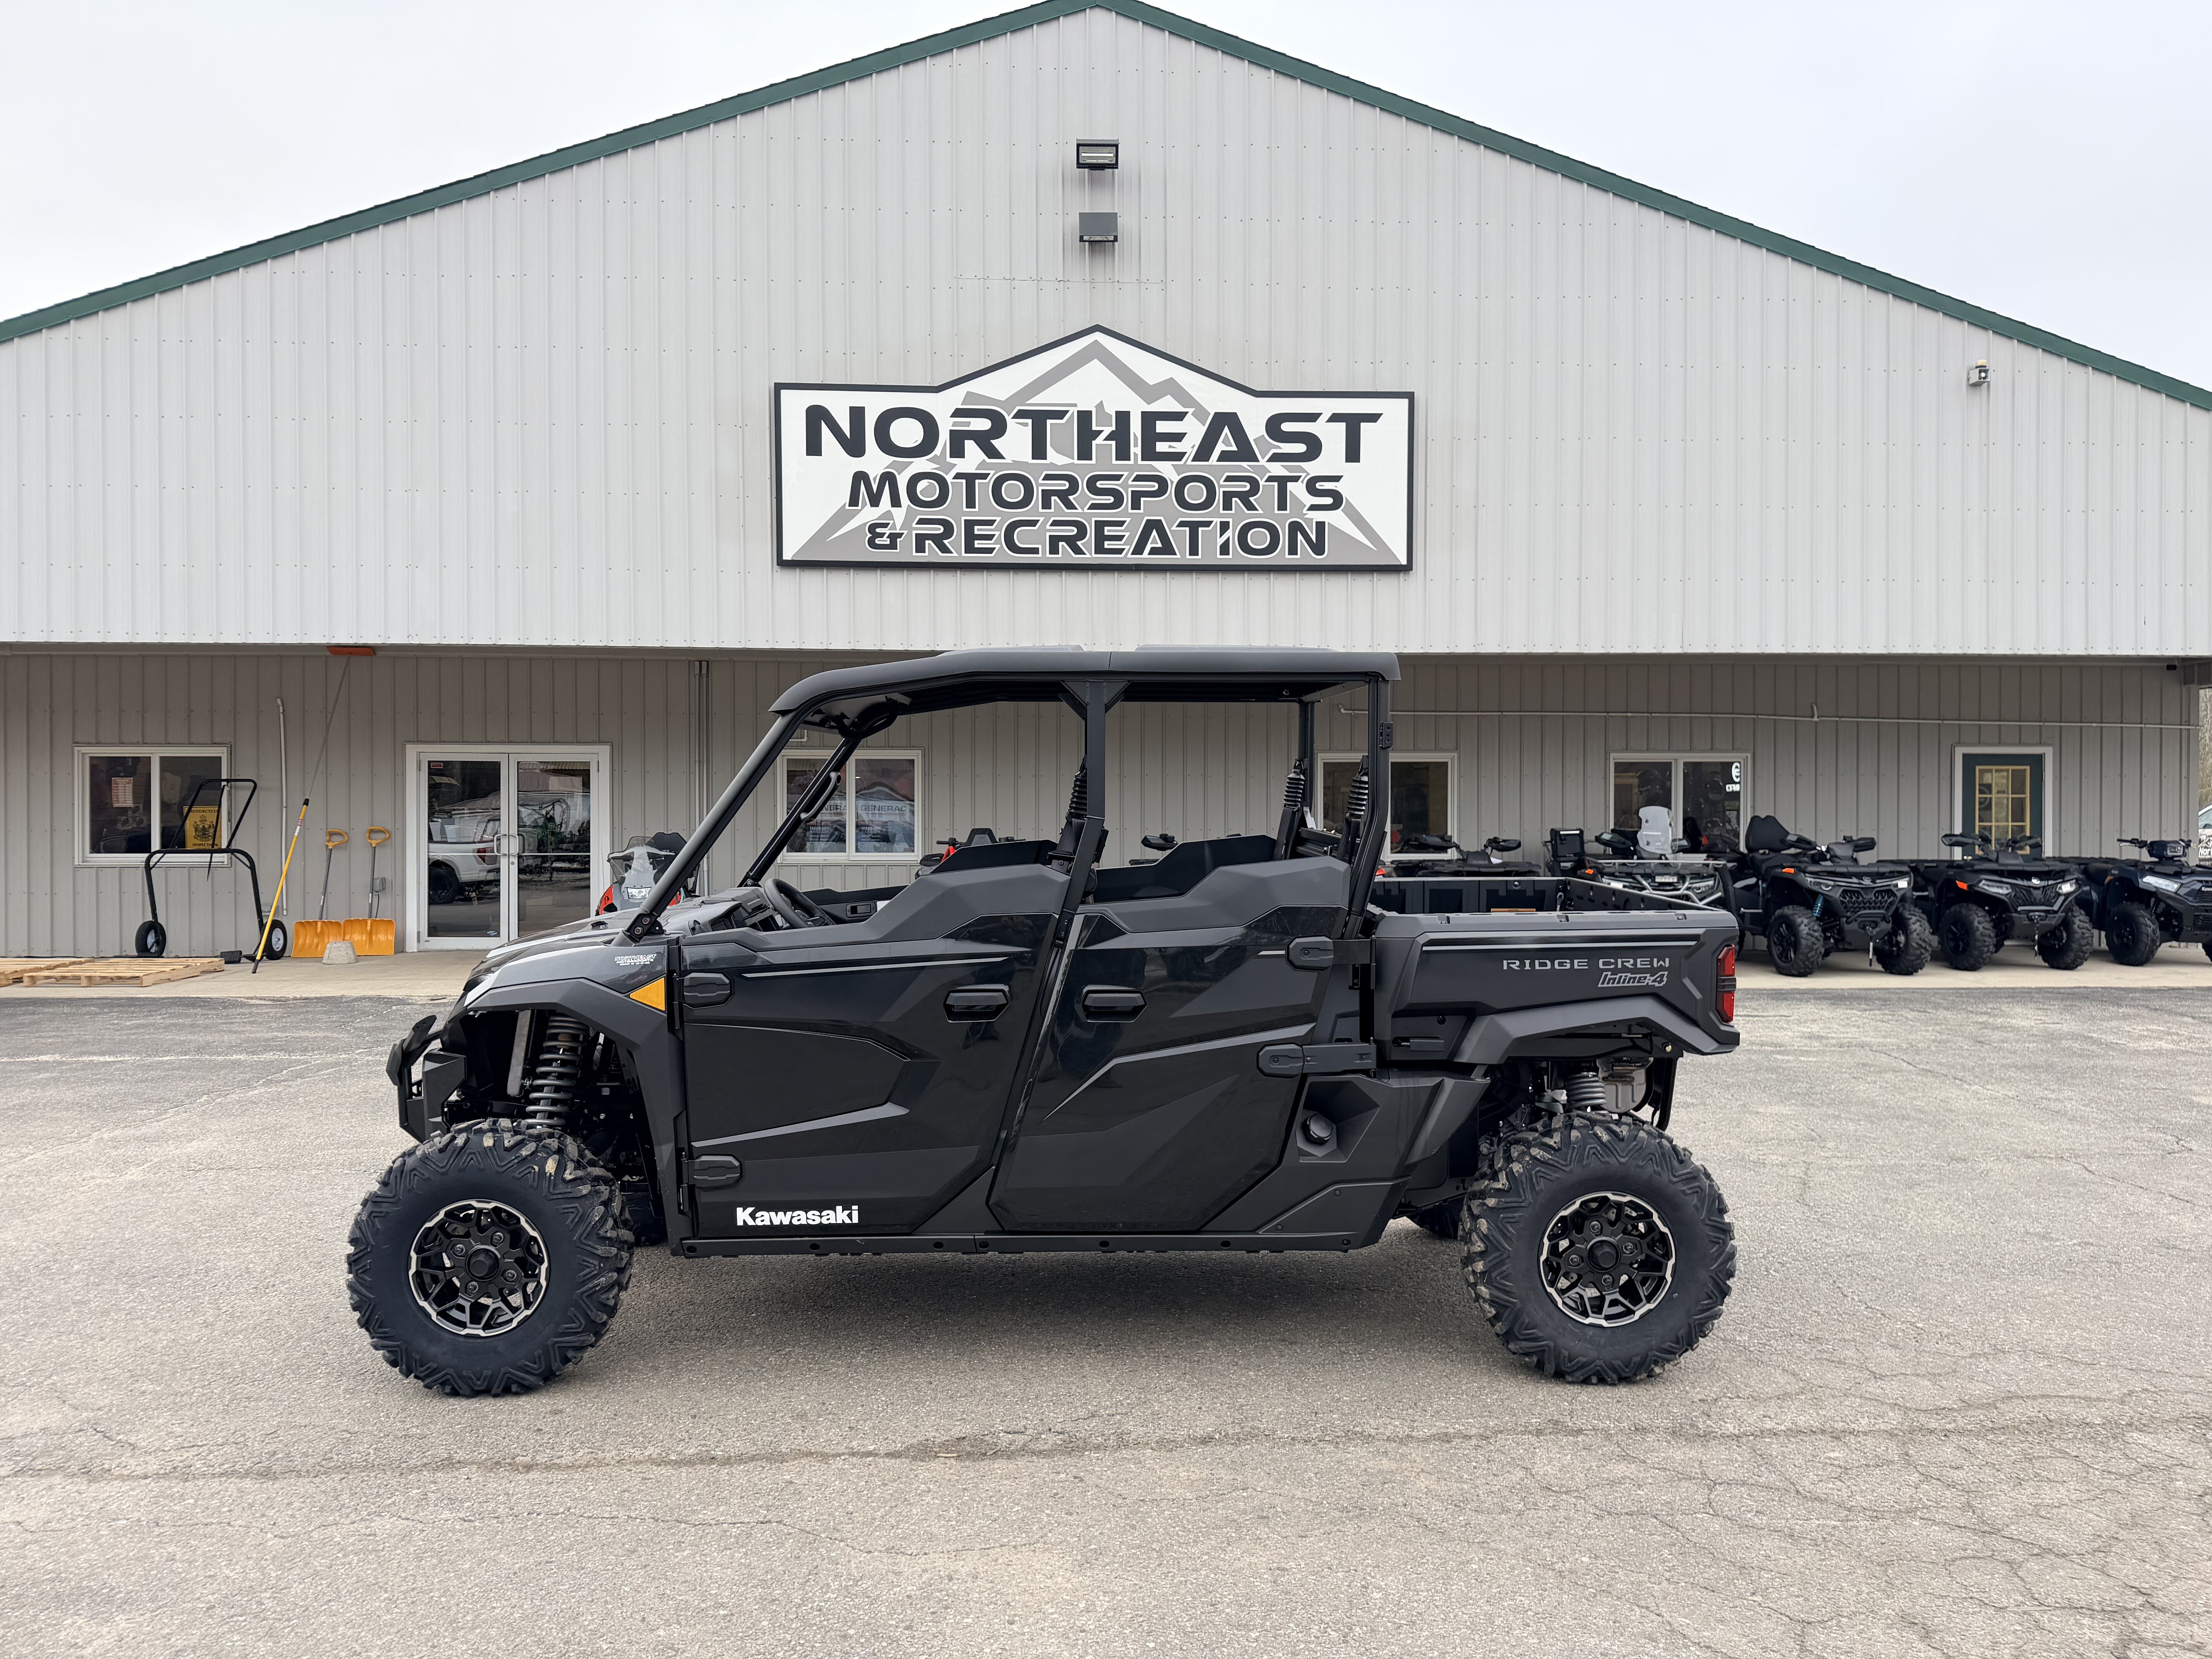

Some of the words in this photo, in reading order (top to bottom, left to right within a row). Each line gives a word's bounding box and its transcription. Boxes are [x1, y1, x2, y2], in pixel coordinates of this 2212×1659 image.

[805, 404, 1384, 463] NORTHEAST
[848, 471, 1344, 512] MOTORSPORTS
[1503, 959, 1588, 970] RIDGE
[1599, 958, 1669, 969] CREW
[736, 1205, 859, 1226] Kawasaki
